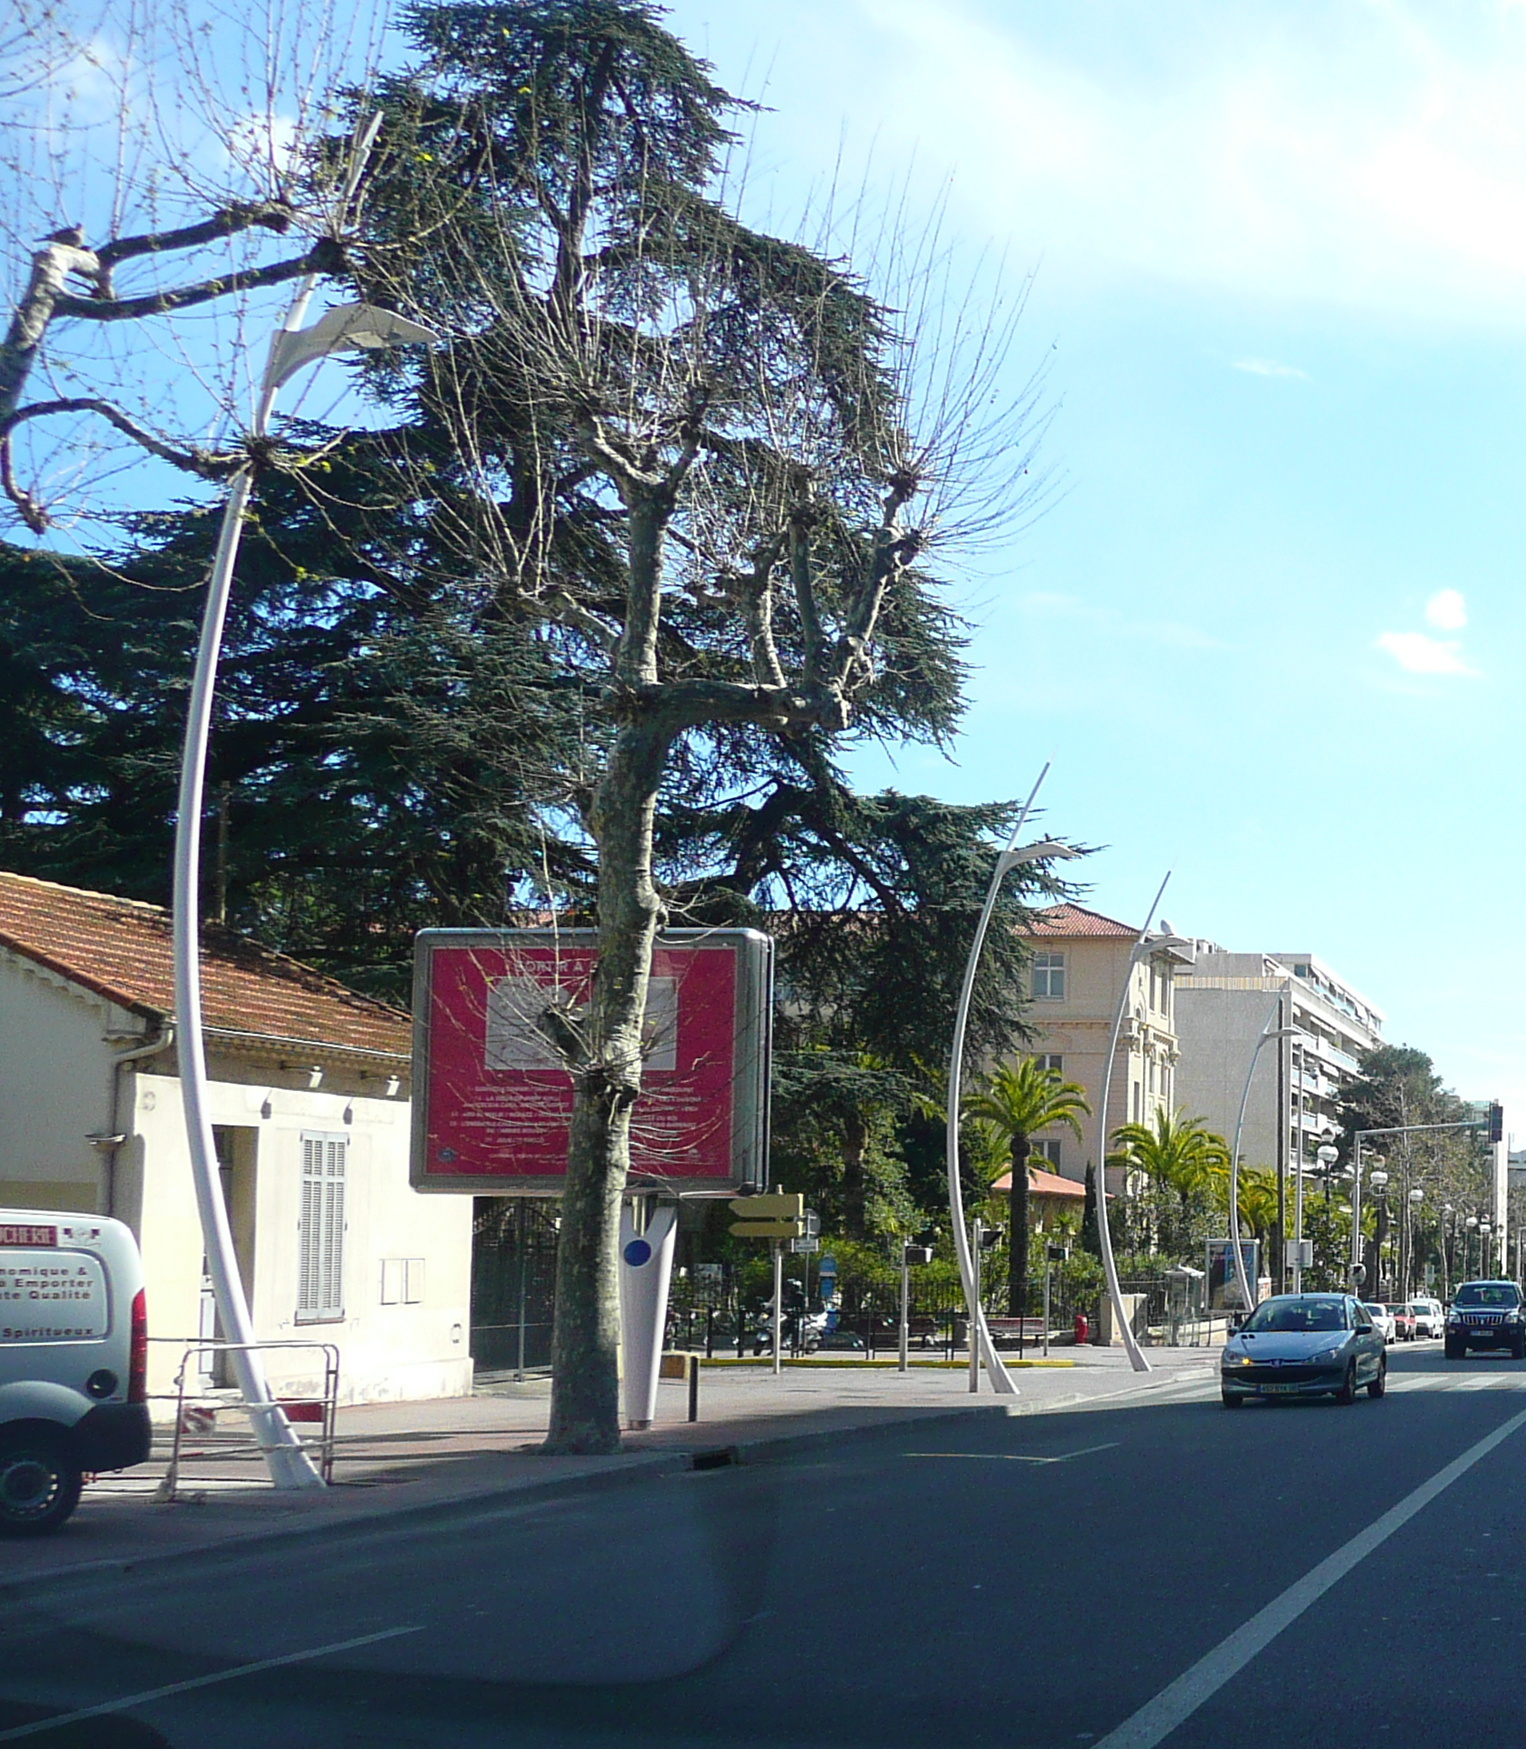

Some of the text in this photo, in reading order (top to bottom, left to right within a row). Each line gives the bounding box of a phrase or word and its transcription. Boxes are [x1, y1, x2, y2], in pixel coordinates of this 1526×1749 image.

[77, 1266, 87, 1276] &
[15, 1279, 94, 1289] Emporter
[2, 1327, 94, 1339] Spiritueux
